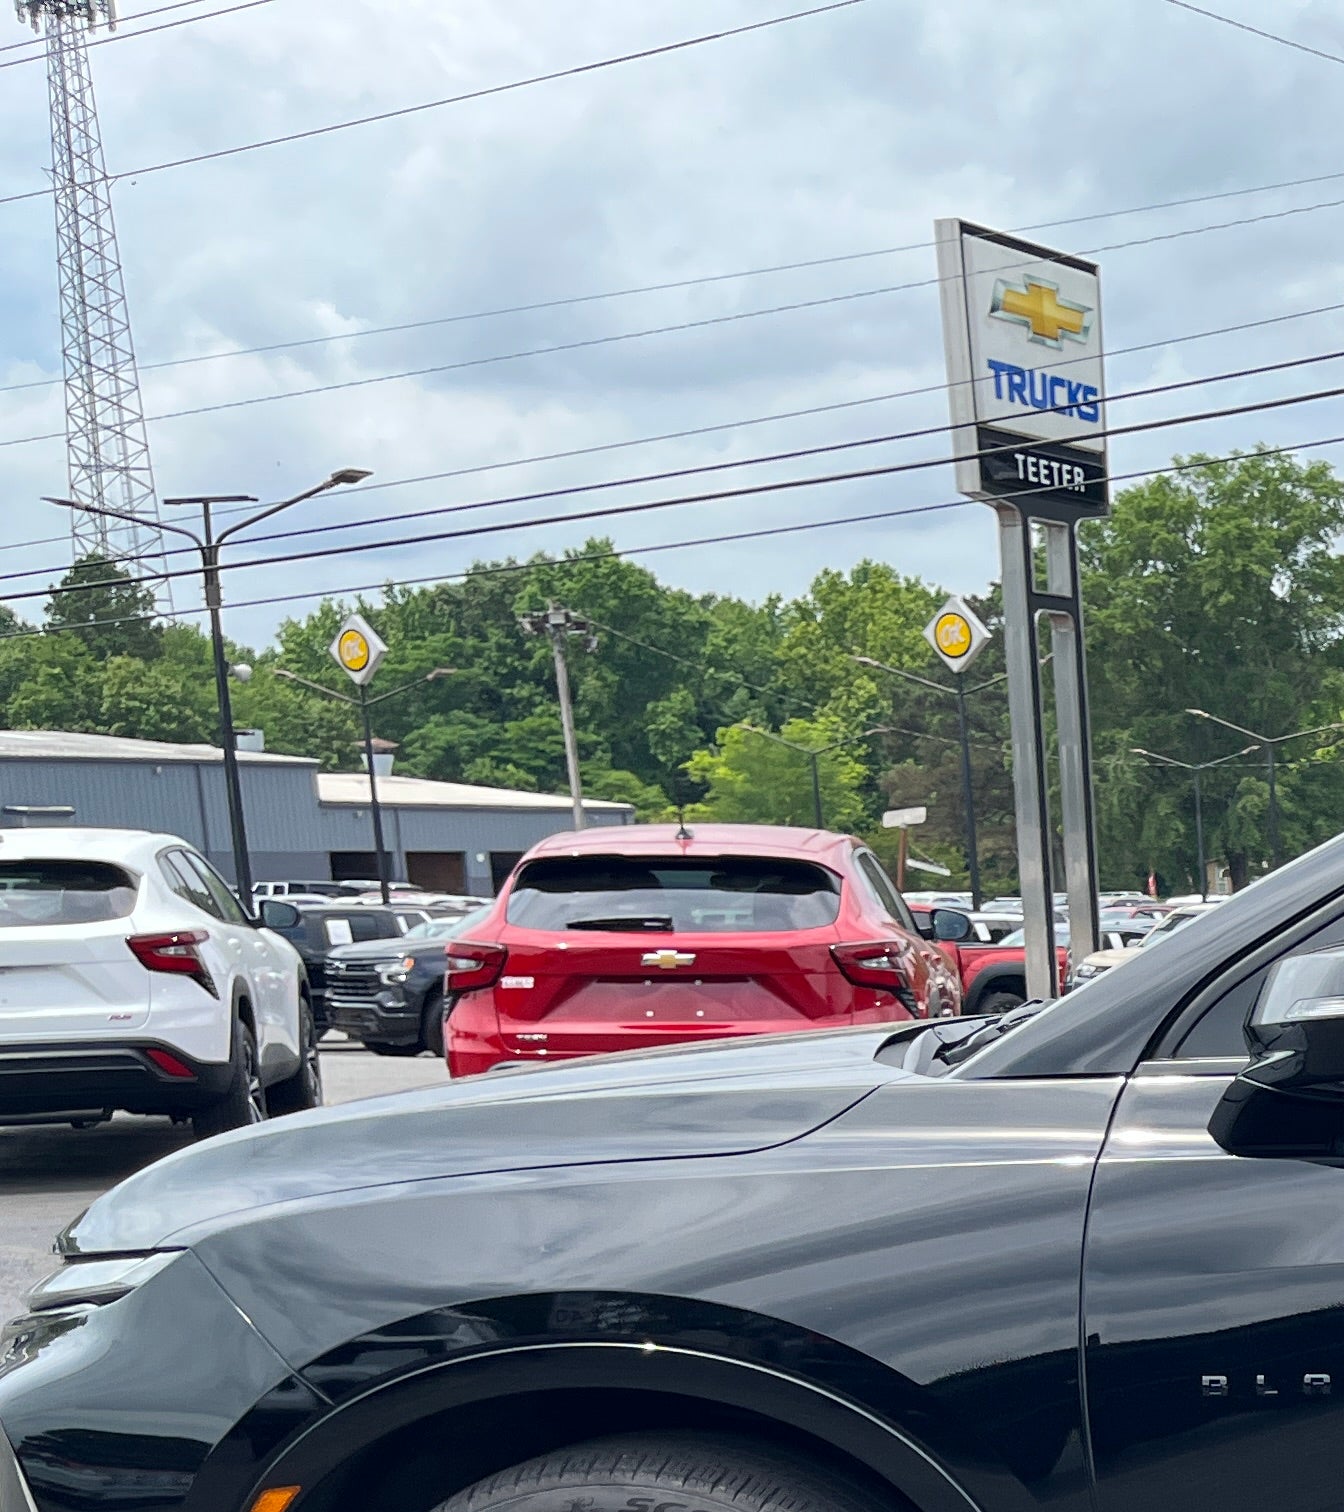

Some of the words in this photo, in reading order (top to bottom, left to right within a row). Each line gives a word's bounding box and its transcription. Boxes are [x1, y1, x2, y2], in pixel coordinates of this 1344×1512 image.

[986, 358, 1099, 423] TRUCKS
[1013, 453, 1086, 492] TEETER
[941, 620, 966, 647] OK
